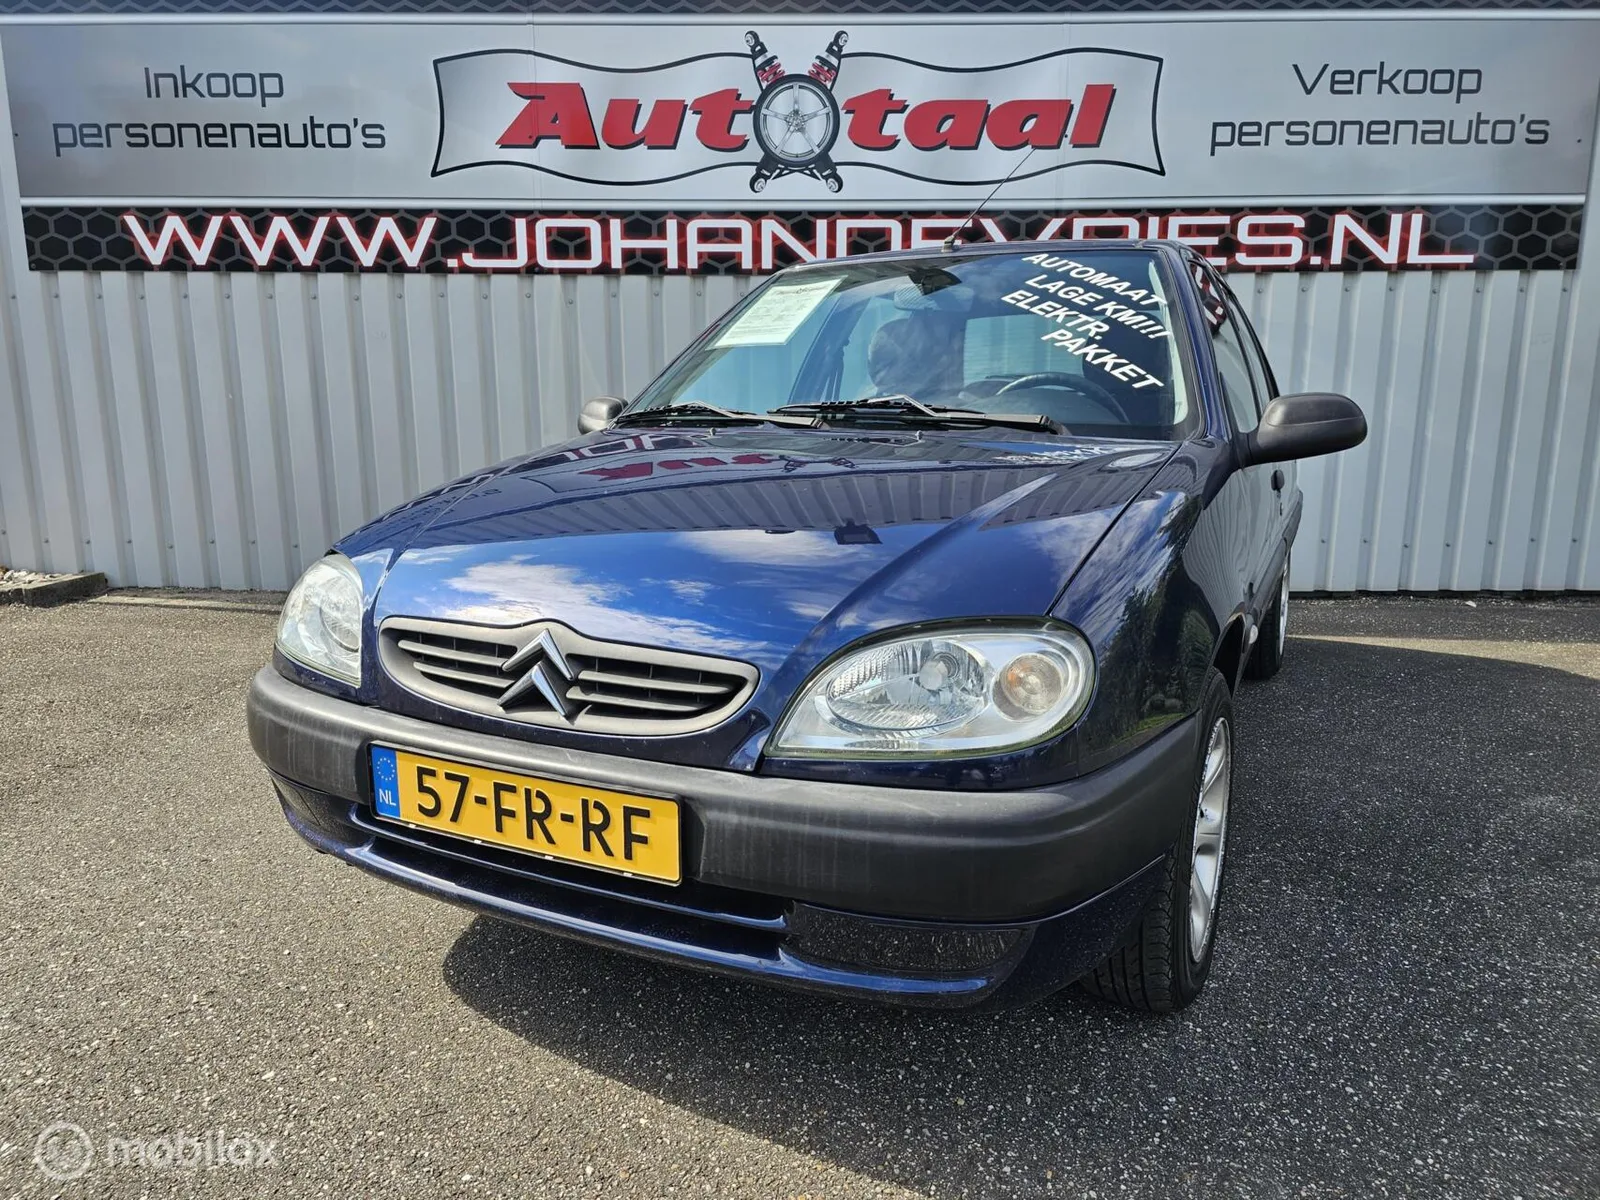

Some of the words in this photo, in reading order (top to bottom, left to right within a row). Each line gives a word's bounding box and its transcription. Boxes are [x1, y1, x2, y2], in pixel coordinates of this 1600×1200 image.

[143, 64, 285, 108] Inkoop
[1291, 61, 1483, 104] Verkoop
[51, 115, 386, 158] personenauto's
[1209, 112, 1550, 157] personenauto's
[1021, 252, 1168, 306] AUTOMAAT
[1000, 289, 1111, 340] ELEKTR.
[1024, 274, 1104, 307] LAGE
[1093, 301, 1172, 339] KM!!!
[1040, 328, 1165, 389] PAKKET
[378, 788, 397, 806] NL
[415, 765, 651, 861] 57-FR-RF
